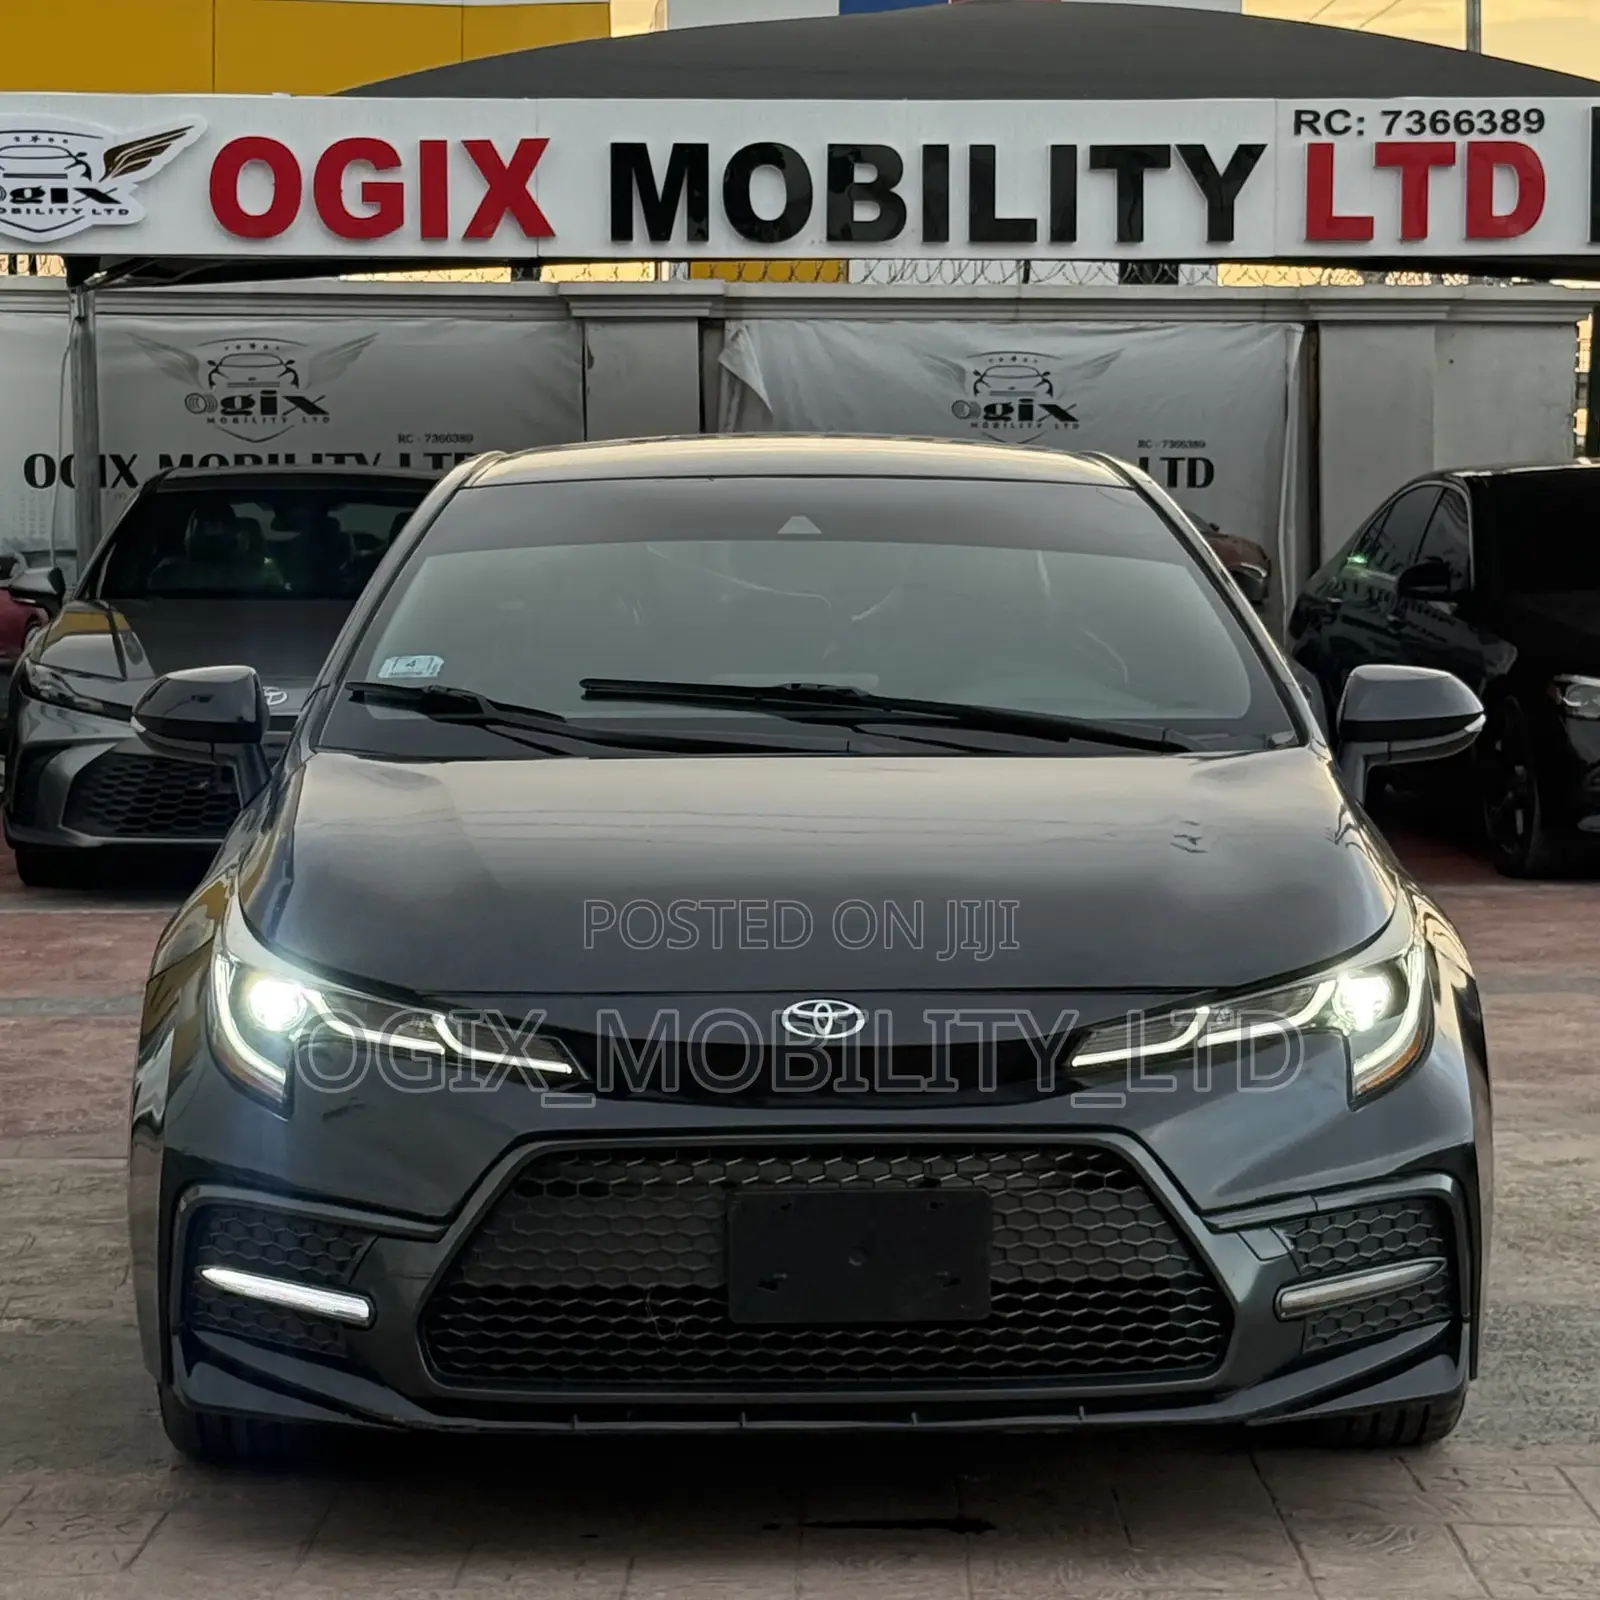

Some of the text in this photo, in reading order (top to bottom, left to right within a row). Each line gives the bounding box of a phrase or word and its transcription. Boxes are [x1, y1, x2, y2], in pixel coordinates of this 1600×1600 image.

[1294, 108, 1545, 136] RC: 7366389
[209, 136, 556, 241] OGIX
[610, 141, 1268, 243] MOBILITY
[1306, 140, 1546, 241] LTD
[207, 416, 330, 424] MOBILITY LTD
